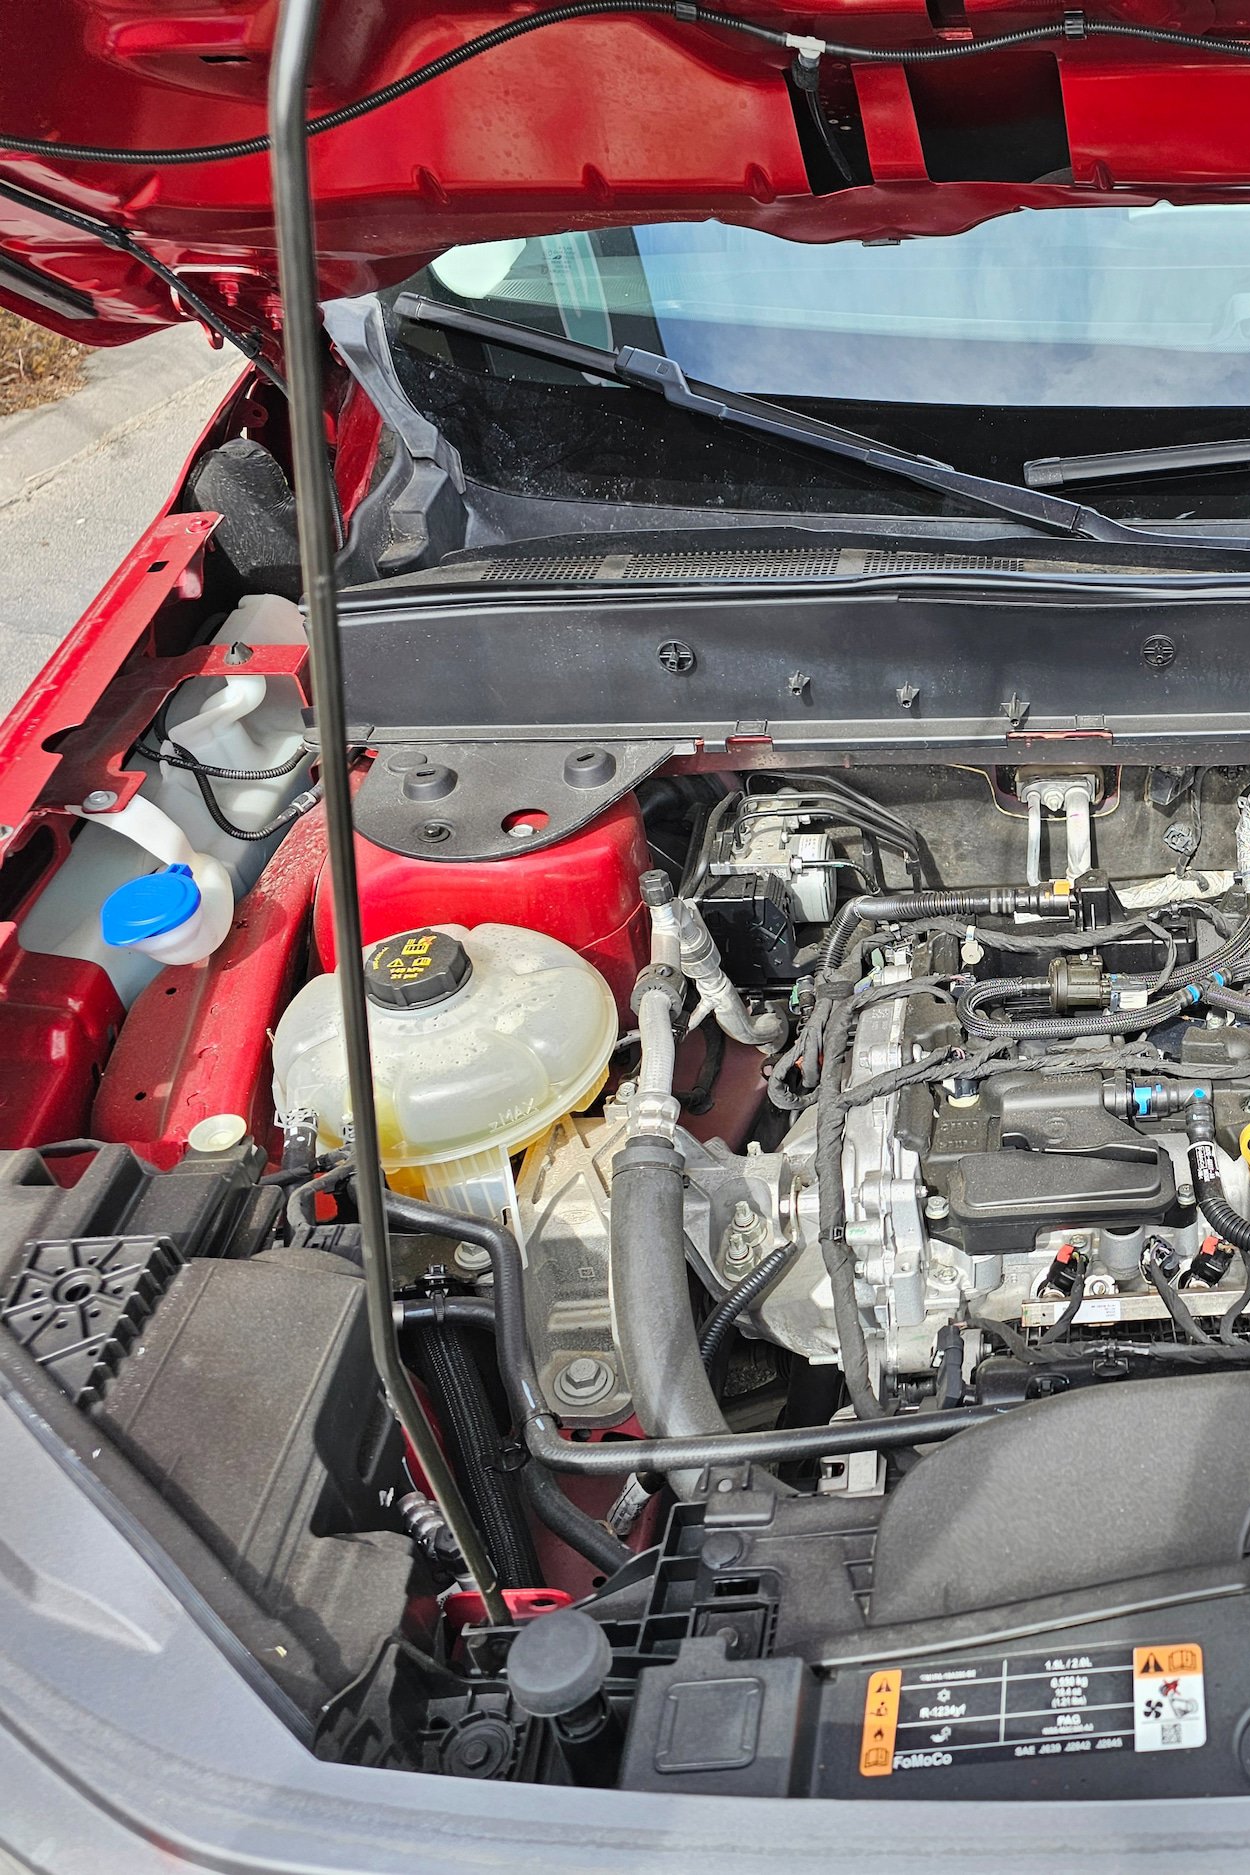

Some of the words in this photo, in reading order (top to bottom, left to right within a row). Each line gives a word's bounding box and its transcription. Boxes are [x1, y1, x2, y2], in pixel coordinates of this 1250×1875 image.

[1071, 1656, 1093, 1668] 2.0L
[1075, 1674, 1089, 1689] kg
[919, 1703, 967, 1719] R-1234yf
[1014, 1744, 1036, 1757] SAE
[893, 1752, 953, 1770] FoMoCo
